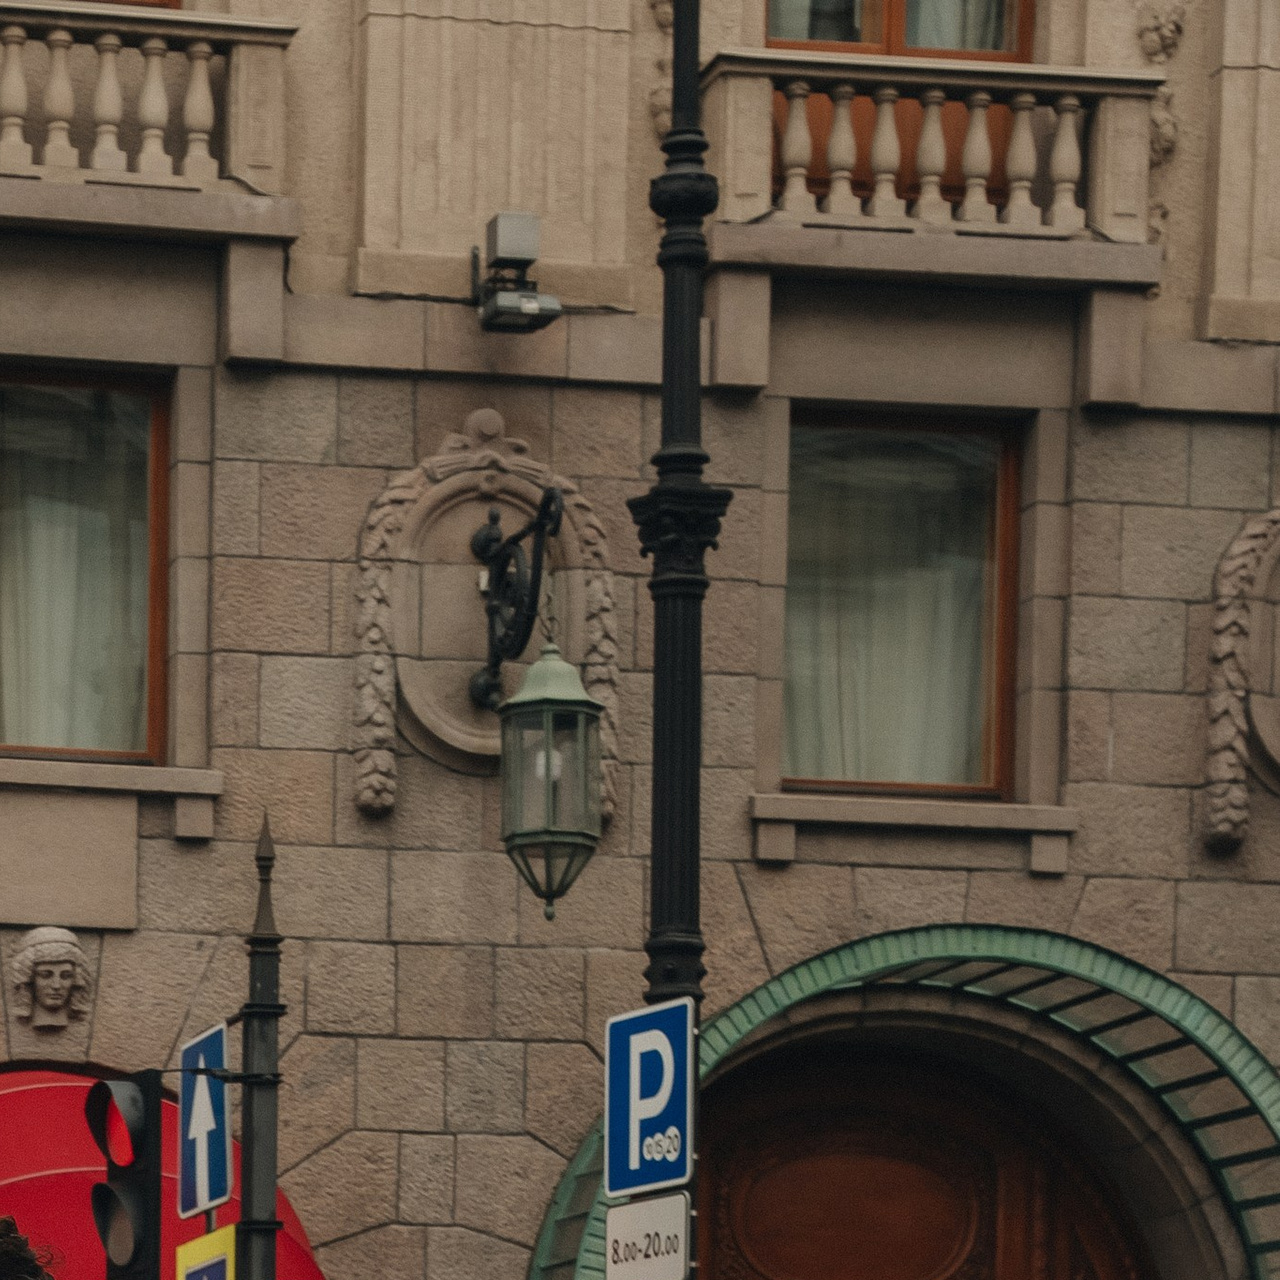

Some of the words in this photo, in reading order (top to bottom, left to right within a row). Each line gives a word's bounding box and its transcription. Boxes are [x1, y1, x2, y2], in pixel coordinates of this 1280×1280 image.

[629, 1028, 675, 1171] P
[666, 1133, 680, 1154] 20
[611, 1231, 680, 1265] 8.00-20.00
